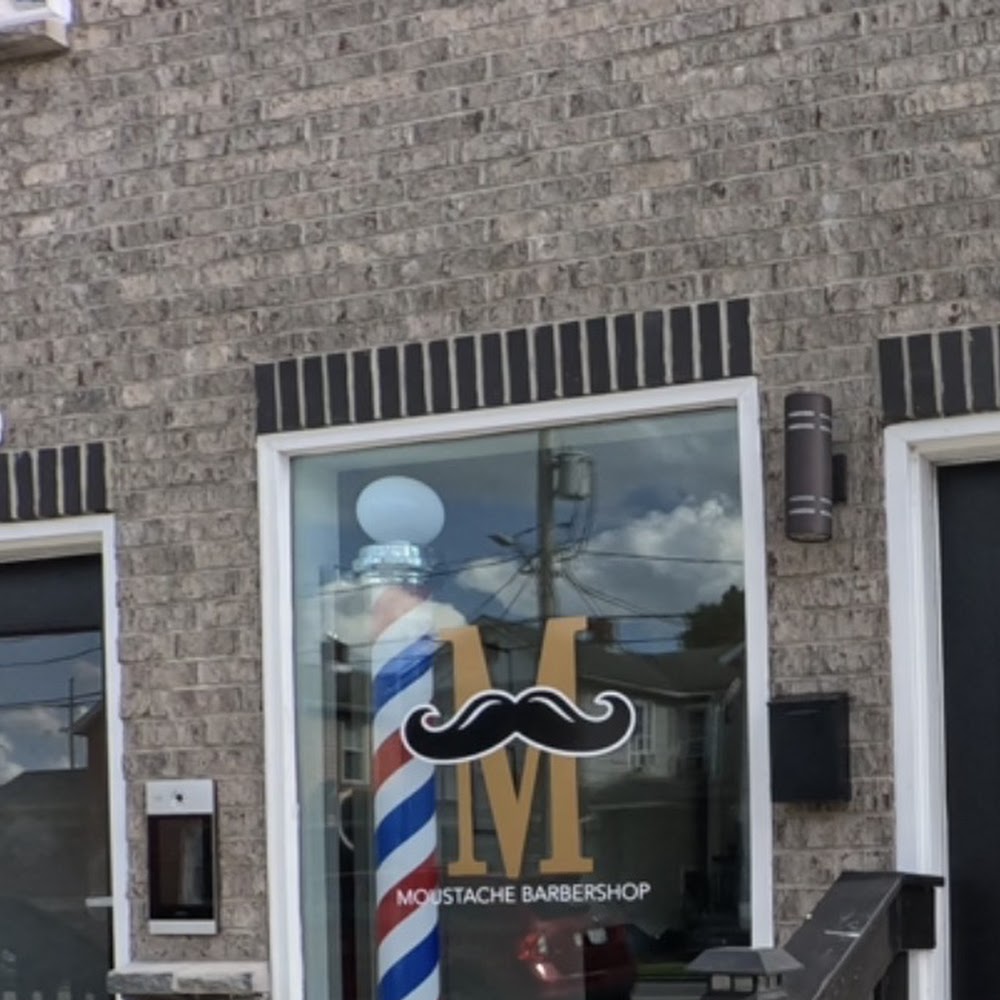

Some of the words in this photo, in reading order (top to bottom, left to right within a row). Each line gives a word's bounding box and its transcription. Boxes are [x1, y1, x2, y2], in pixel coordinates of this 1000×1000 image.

[438, 616, 594, 879] M
[395, 885, 517, 906] MOUSTACHE
[521, 881, 651, 903] BARBERSHOP
